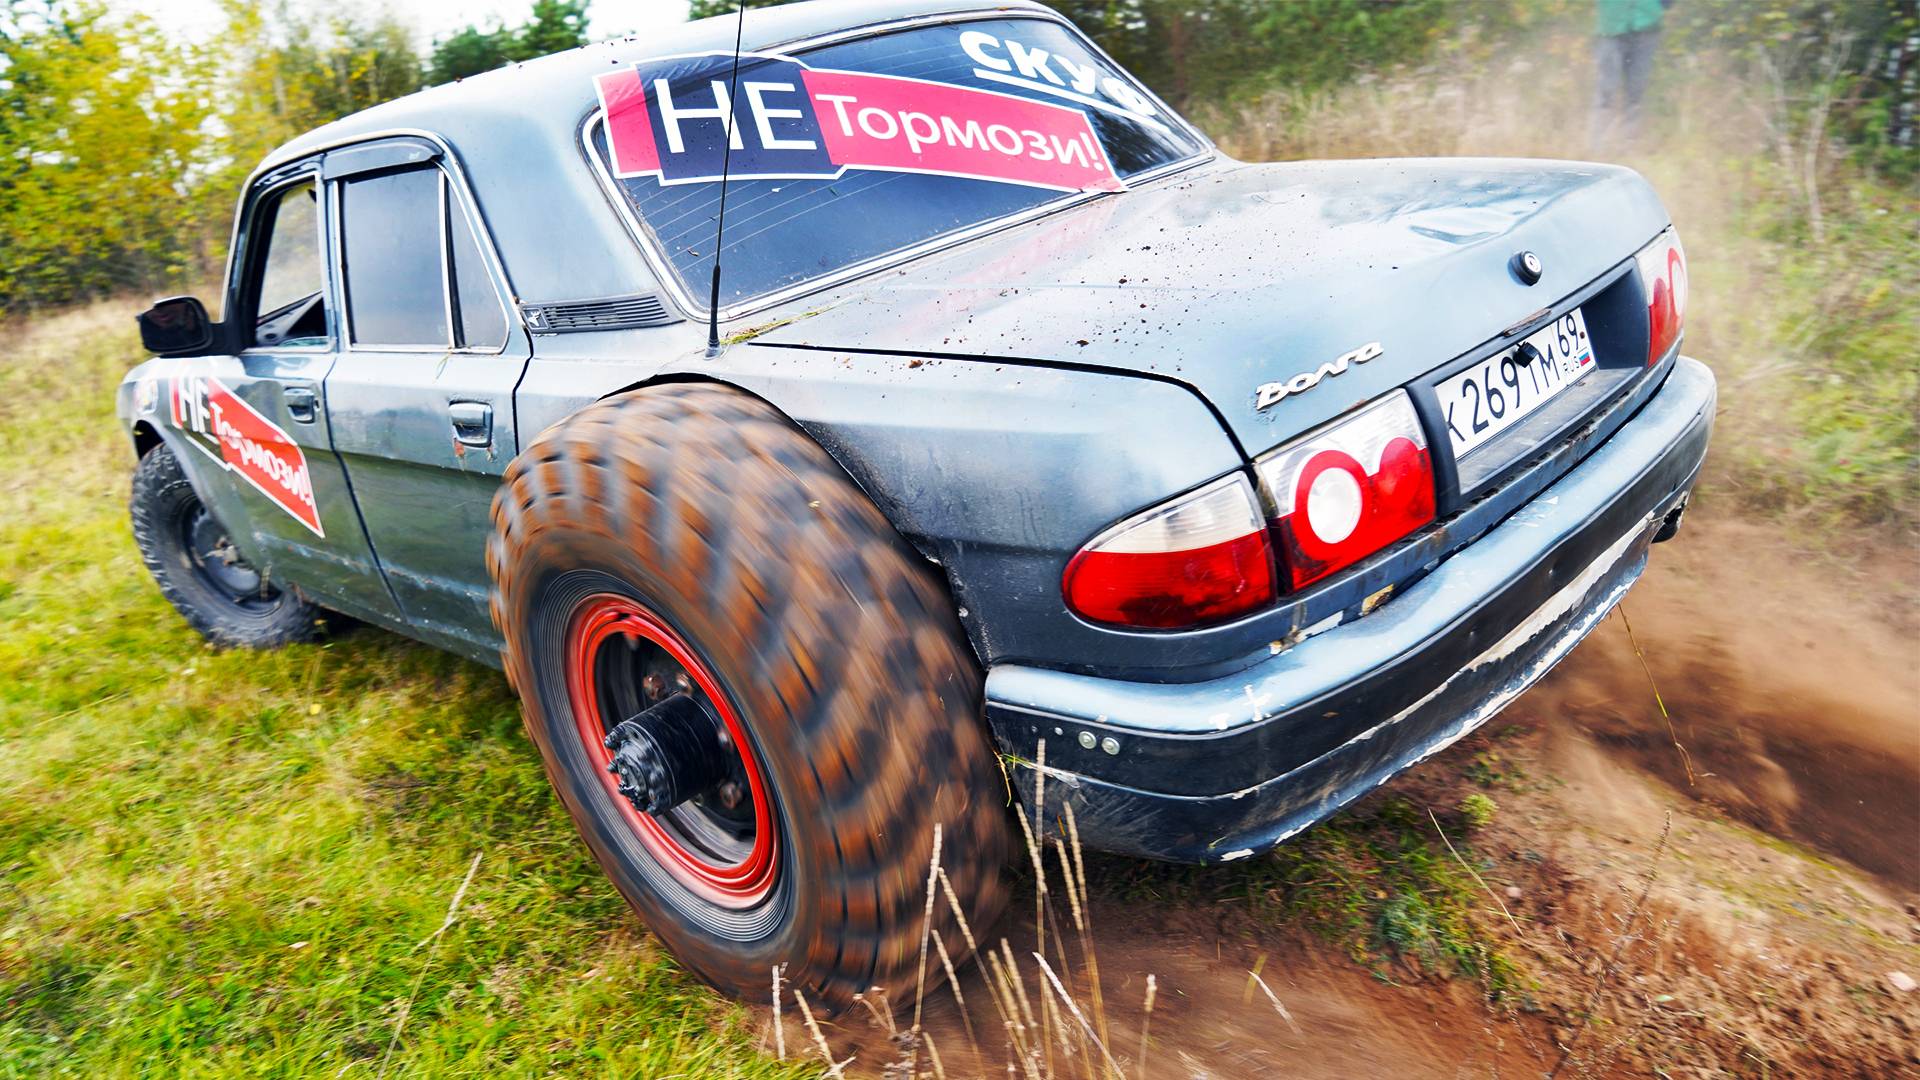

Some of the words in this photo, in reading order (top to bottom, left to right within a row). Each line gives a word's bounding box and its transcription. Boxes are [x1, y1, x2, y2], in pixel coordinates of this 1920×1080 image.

[652, 77, 818, 154] НЕ
[814, 92, 1107, 172] Тормози!
[1555, 312, 1579, 358] 69
